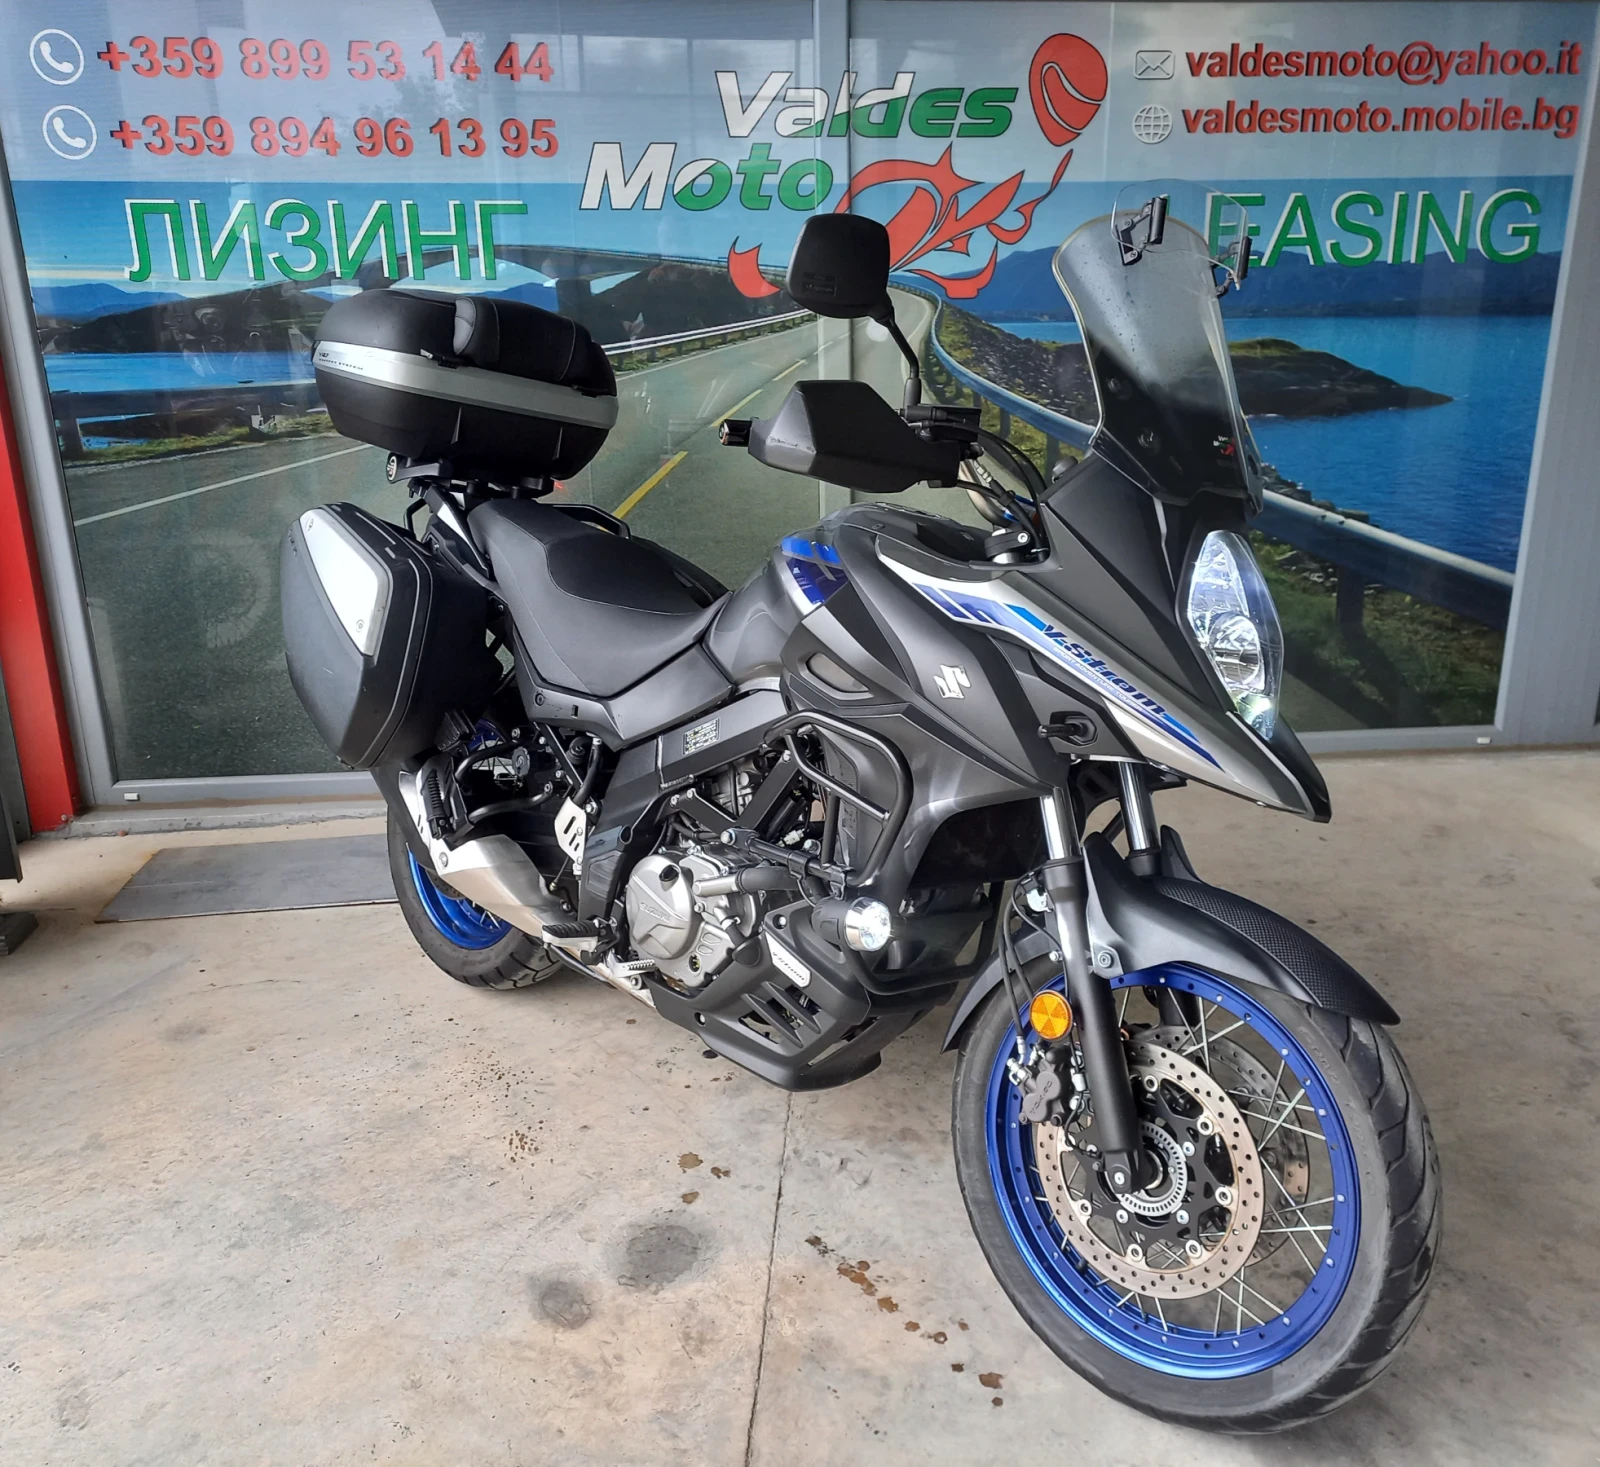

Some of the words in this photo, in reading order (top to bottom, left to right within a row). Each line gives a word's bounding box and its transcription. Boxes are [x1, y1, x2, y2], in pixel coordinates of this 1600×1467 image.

[97, 36, 224, 81] +359
[239, 38, 332, 82] 899
[347, 39, 405, 82] 53
[421, 41, 482, 82] 14
[494, 41, 554, 83] 44
[1185, 41, 1583, 86] valdesmoto@yahoo.it
[110, 115, 235, 157] +359
[250, 115, 341, 157] 894
[355, 117, 414, 158] 96
[429, 117, 487, 158] 13
[500, 118, 559, 159] 95
[714, 70, 1019, 138] Valdes
[1183, 97, 1580, 139] valdesmoto.mobile.bg
[579, 142, 834, 211] Moto
[123, 197, 527, 282] ЛИЗИНГ
[1160, 188, 1542, 266] EASING
[1043, 624, 1166, 715] V-Strom
